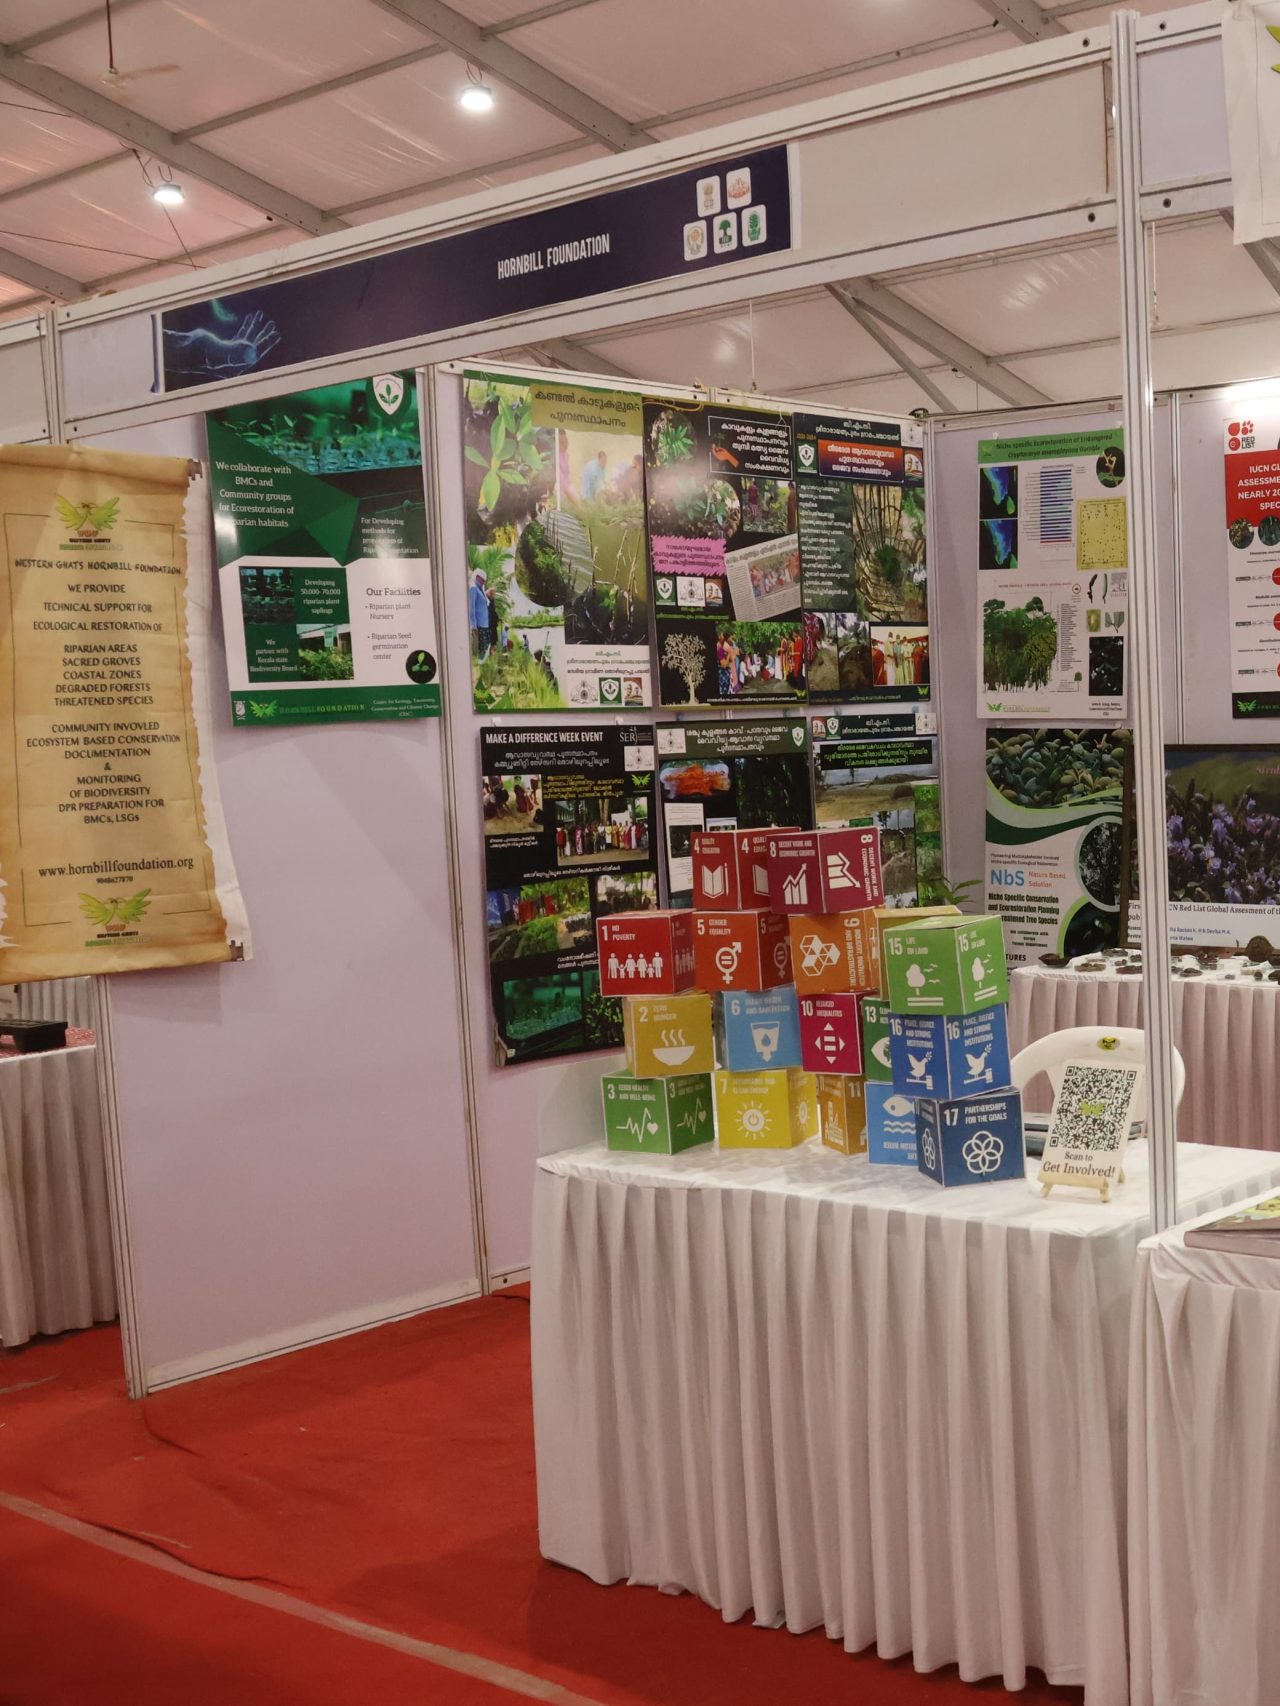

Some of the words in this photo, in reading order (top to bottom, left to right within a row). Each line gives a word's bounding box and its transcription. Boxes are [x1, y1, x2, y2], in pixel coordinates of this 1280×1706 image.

[498, 251, 544, 280] HORNBILL
[547, 233, 610, 268] FOUNDATION
[216, 461, 229, 470] We
[230, 463, 272, 474] collaborate
[273, 465, 291, 475] with
[1249, 464, 1270, 474] IUCN
[235, 476, 258, 486] BMCs
[259, 478, 273, 487] and
[220, 489, 264, 501] Community
[265, 493, 292, 503] groups
[1238, 489, 1271, 500] NEARLY
[231, 504, 285, 514] Ecorestoration
[286, 506, 294, 514] of
[15, 558, 53, 568] WESTERN
[56, 560, 84, 571] GHATS
[88, 561, 132, 571] HORNBILL
[135, 563, 181, 575] FOUNDATION
[68, 584, 82, 593] WE
[84, 584, 126, 593] PROVIDE
[366, 587, 381, 597] Our
[44, 602, 91, 612] TECHNICAL
[94, 603, 137, 612] SUPPORT
[138, 603, 152, 613] FOR
[33, 621, 88, 631] ECOLOGICAL
[91, 621, 152, 632] RESTORATION
[64, 644, 106, 653] RIPARIAN
[107, 644, 138, 653] AREAS
[62, 657, 100, 666] SACRED
[102, 657, 141, 666] GROVES
[63, 671, 107, 680] COASTAL
[109, 670, 142, 680] ZONES
[55, 684, 108, 694] DEGRADED
[109, 683, 151, 692] FORESTS
[55, 697, 115, 706] THREATENED
[117, 695, 154, 705] SPECIES
[52, 723, 111, 733] COMMUNITY
[27, 738, 79, 748] ECOSYSTEM
[83, 736, 115, 745] BASED
[118, 734, 181, 745] CONSERVATION
[486, 733, 508, 744] MAKE
[508, 732, 514, 744] A
[515, 732, 559, 744] DIFFERENCE
[559, 731, 581, 743] WEEK
[581, 731, 604, 742] EVENT
[64, 748, 151, 759] DOCUMENTATION
[104, 762, 112, 771] &
[77, 774, 141, 785] MONITORING
[70, 789, 82, 799] OF
[84, 787, 151, 798] BIODIVERSITY
[59, 803, 77, 813] DPR
[79, 801, 144, 811] PREPARATION
[146, 799, 164, 808] FOR
[116, 813, 140, 823] LSGs
[694, 838, 701, 852] 4
[741, 837, 750, 853] 4
[861, 834, 873, 844] 8
[769, 842, 777, 858] 8
[39, 857, 194, 878] www.hornbillfoundation.org
[990, 869, 1025, 887] NbS
[1179, 904, 1191, 913] Red
[1193, 905, 1205, 914] List
[1207, 905, 1228, 915] Global
[1267, 907, 1275, 915] of
[602, 926, 609, 941] 1
[697, 919, 705, 935] 5
[612, 933, 636, 942] POVERTY
[958, 933, 969, 953] 15
[888, 938, 903, 955] 15
[639, 1006, 648, 1022] 2
[731, 1000, 740, 1016] 6
[800, 1000, 814, 1016] 10
[865, 1006, 877, 1023] 13
[890, 1018, 902, 1036] 16
[946, 1021, 960, 1041] 16
[608, 1083, 616, 1099] 3
[964, 1102, 1007, 1115] PARTNERSHIPS
[944, 1107, 959, 1126] 17
[966, 1116, 977, 1125] FOR
[978, 1115, 988, 1123] THE
[988, 1112, 1007, 1122] GOALS
[1064, 1151, 1084, 1161] Scan
[1085, 1152, 1093, 1162] to
[1042, 1160, 1060, 1173] Get
[1063, 1162, 1116, 1178] Involved!
